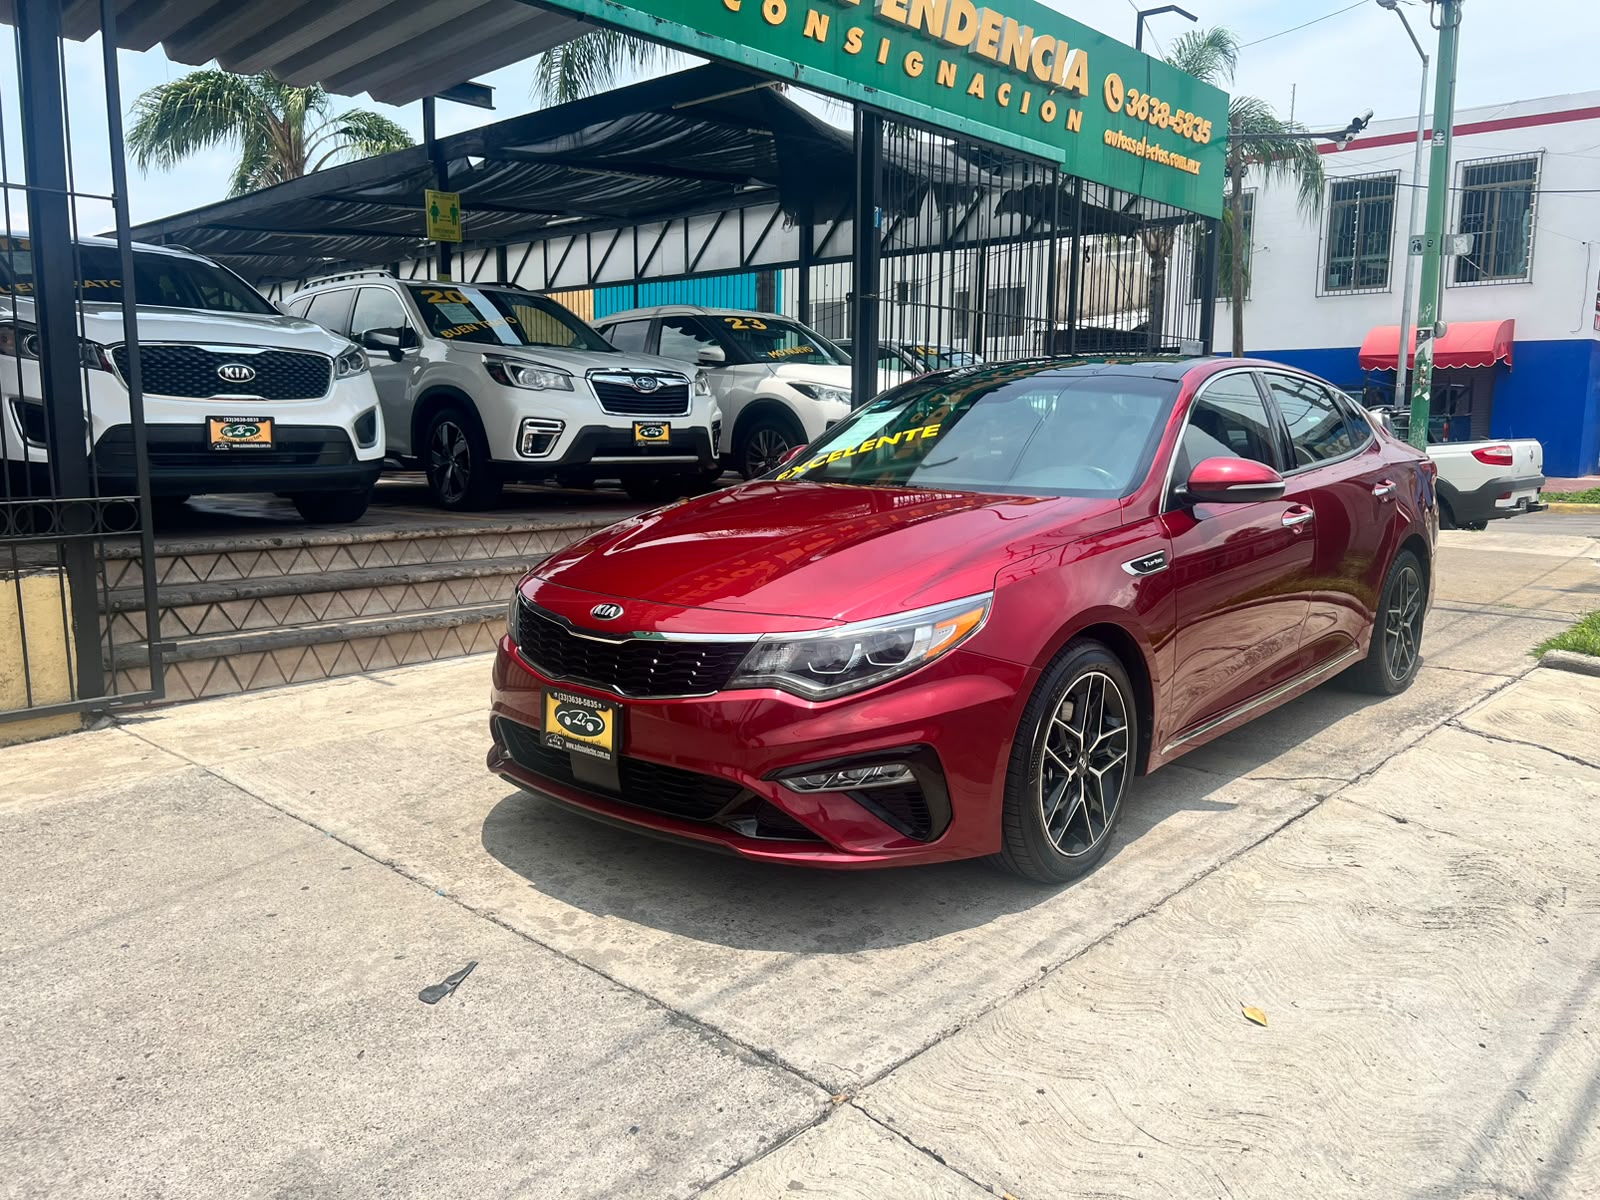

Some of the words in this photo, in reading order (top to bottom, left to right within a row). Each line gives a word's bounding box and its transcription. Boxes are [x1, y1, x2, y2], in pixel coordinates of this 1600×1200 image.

[846, 0, 1089, 97] NDENCIA
[1126, 88, 1212, 144] 3638-5835
[1104, 129, 1201, 175] autosselectos.com.mx
[421, 289, 470, 304] 20
[440, 323, 480, 338] BUEN
[724, 317, 768, 329] 23
[224, 367, 250, 379] KIA
[775, 424, 941, 481] EXCELENTE
[1143, 557, 1164, 567] Turbo
[593, 604, 617, 617] KIA
[558, 692, 598, 708] (33)3638-5835
